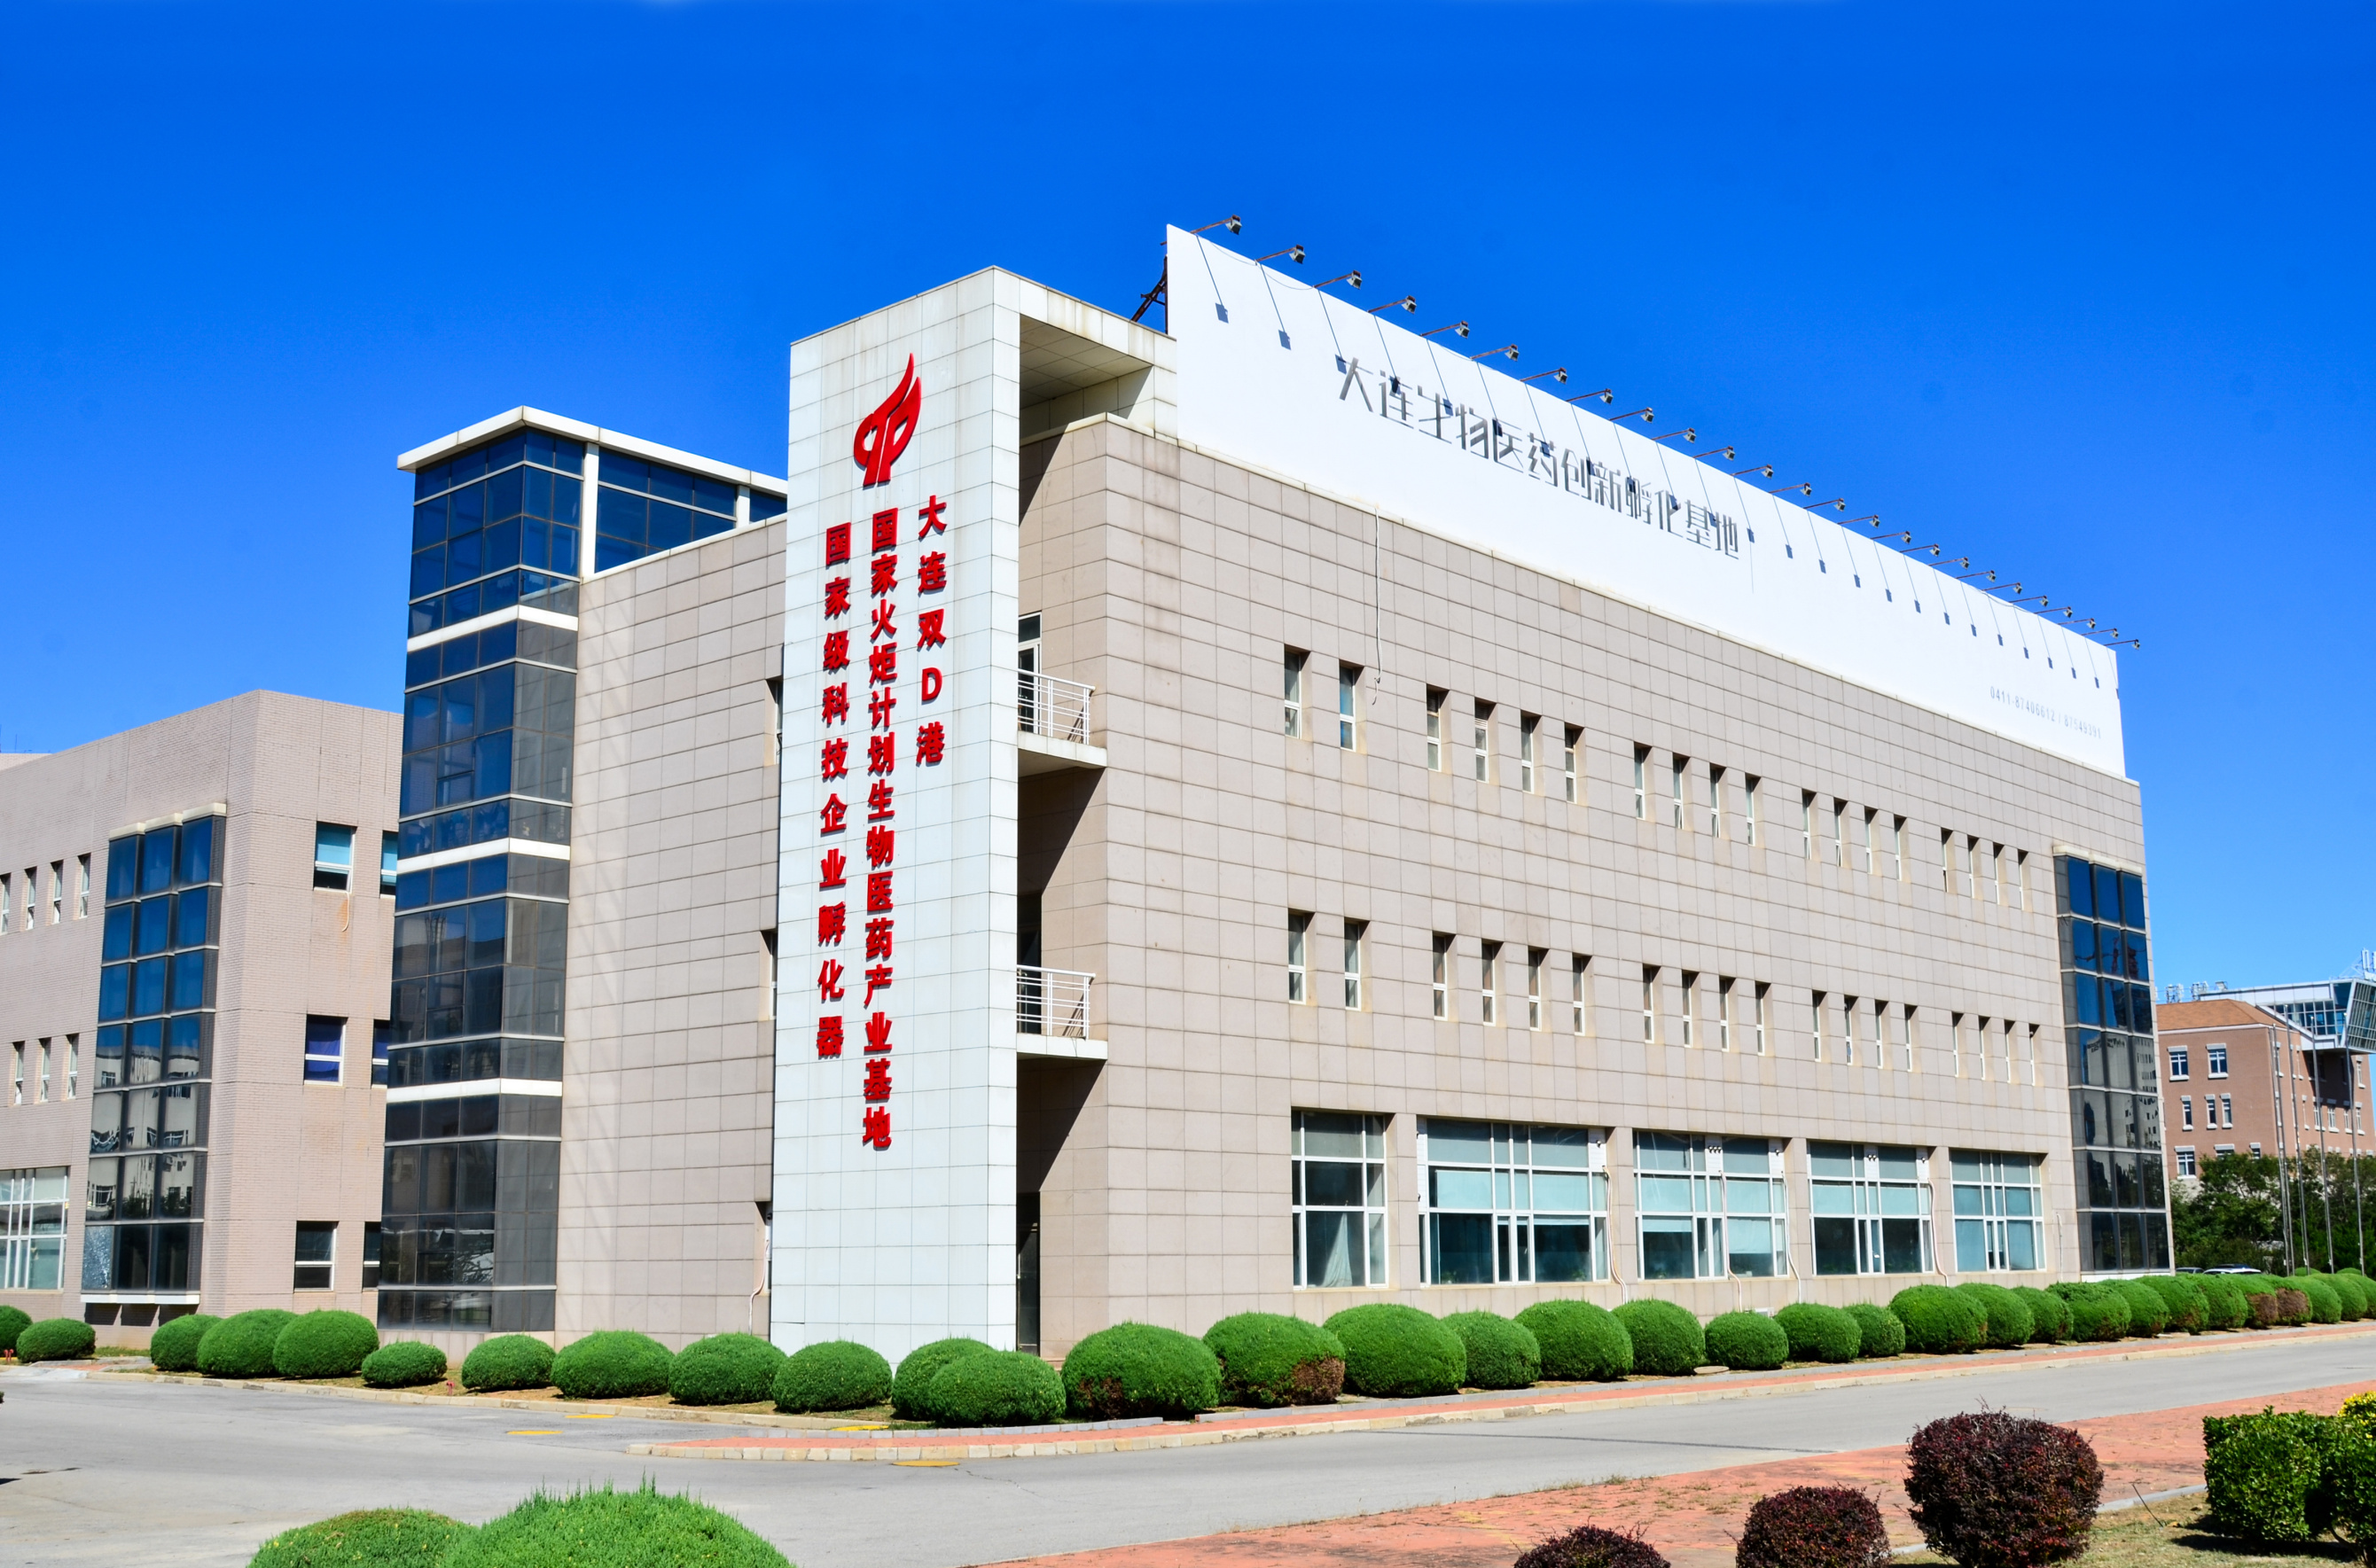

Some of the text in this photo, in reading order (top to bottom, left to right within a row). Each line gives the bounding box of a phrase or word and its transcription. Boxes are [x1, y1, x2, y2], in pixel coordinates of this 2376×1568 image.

[1339, 356, 1741, 560] 大连生物医药创新孵化基地
[917, 495, 947, 763] 大连双D港
[1989, 685, 2055, 722] 0411-87406612
[816, 521, 852, 1057] 国家级科技企业孵化器
[863, 507, 899, 1149] 国家火炬计划生物医药产业基地
